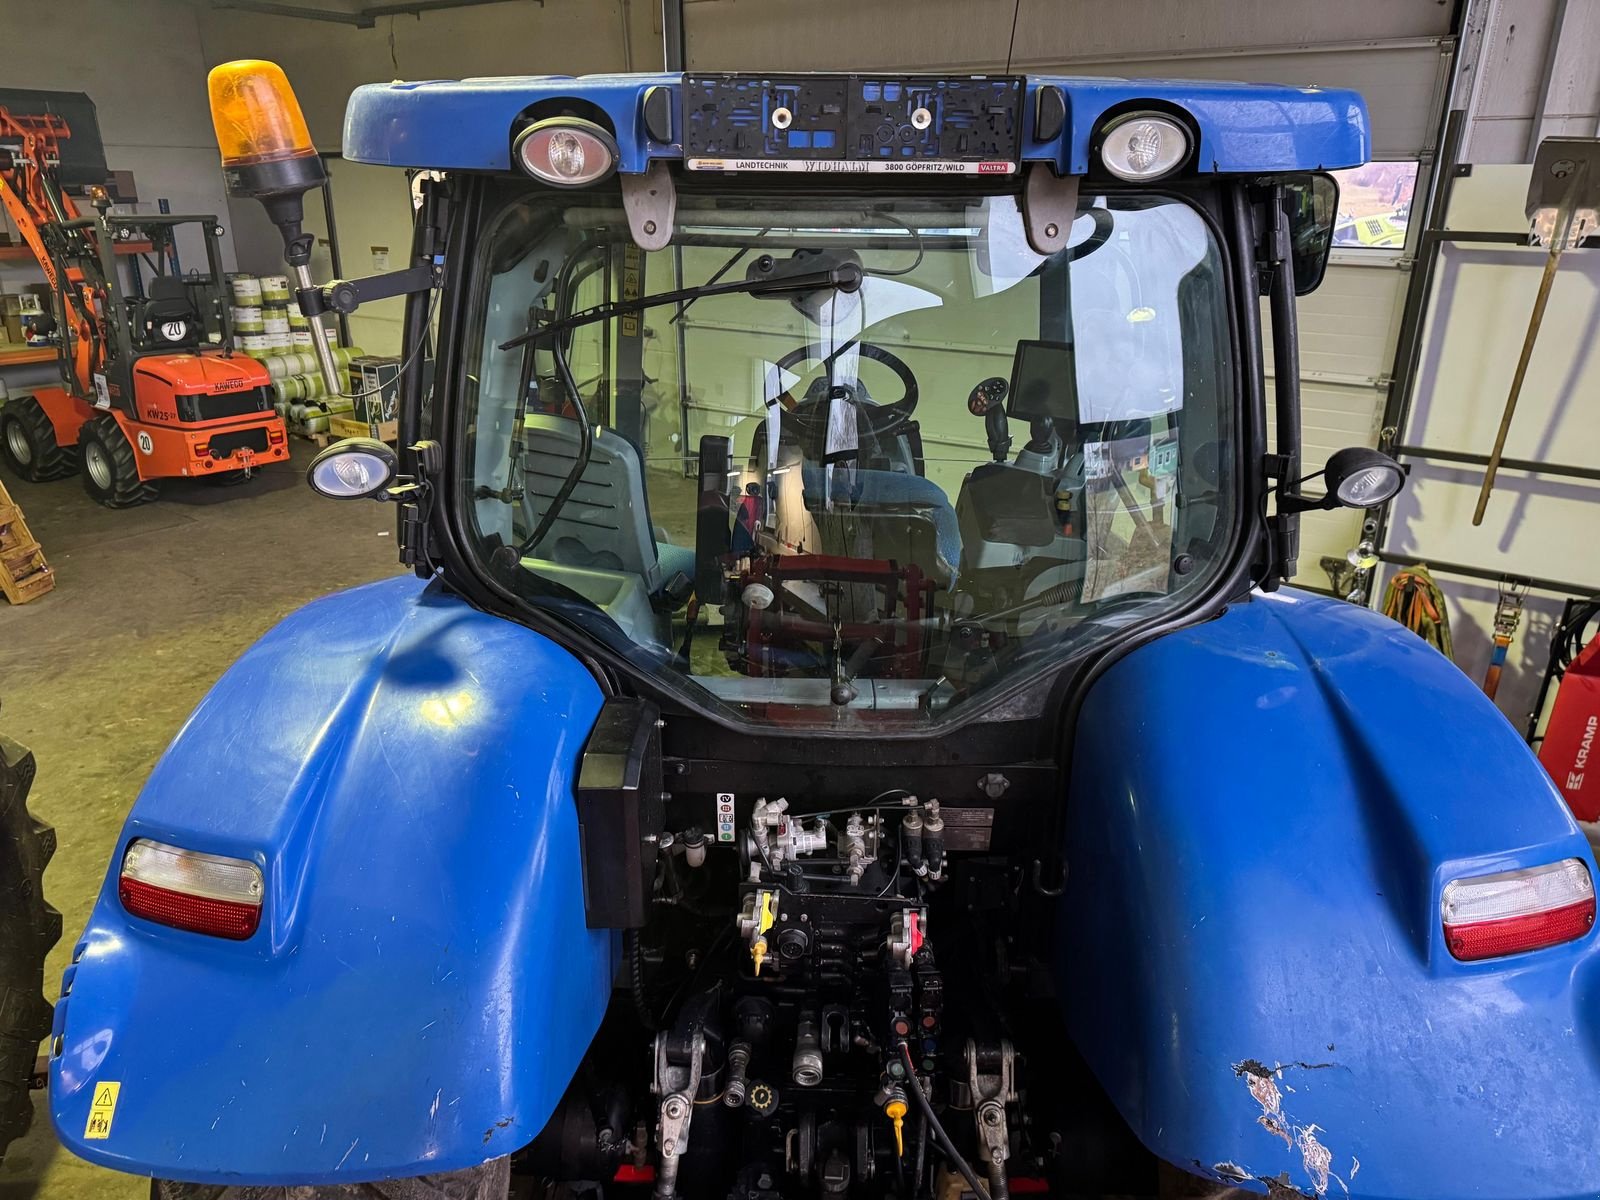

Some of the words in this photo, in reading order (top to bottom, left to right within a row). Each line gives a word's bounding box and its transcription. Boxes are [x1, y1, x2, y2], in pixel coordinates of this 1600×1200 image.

[735, 161, 789, 170] LANDTECHNIK
[803, 161, 870, 172] WIDHALM
[884, 163, 904, 171] 3800
[905, 161, 965, 172] GÖPFRITZ/WILD
[980, 164, 1006, 172] VALTRA
[167, 322, 181, 336] 20
[214, 380, 244, 391] KAWECO
[140, 435, 151, 448] 20
[1574, 715, 1598, 769] KRAMP
